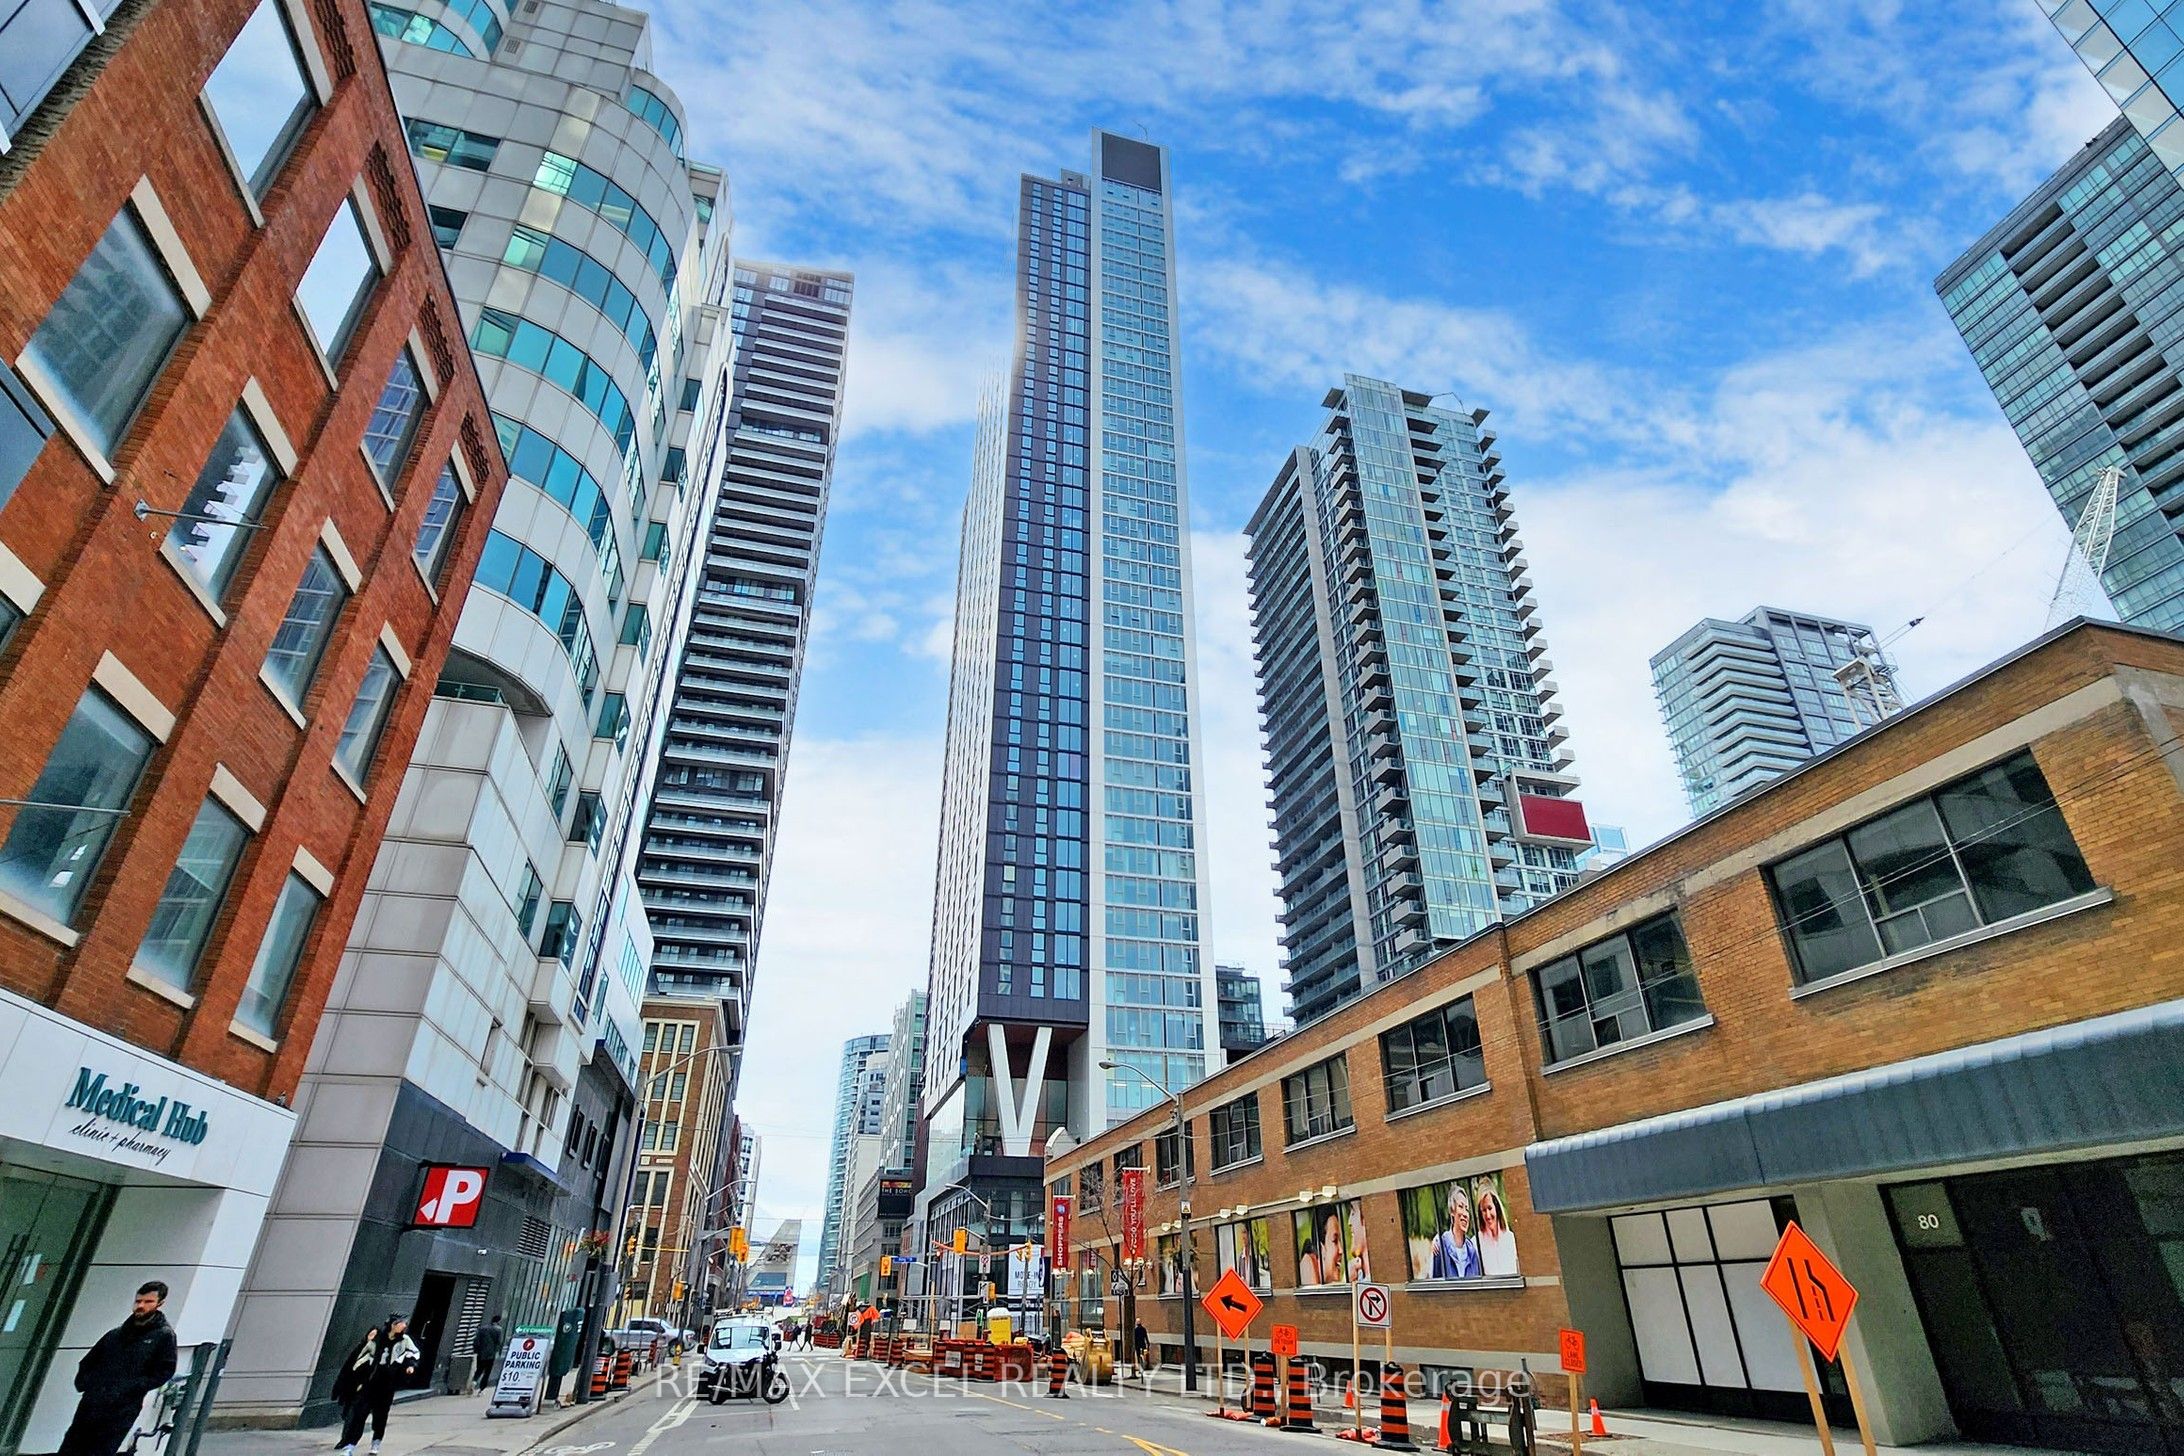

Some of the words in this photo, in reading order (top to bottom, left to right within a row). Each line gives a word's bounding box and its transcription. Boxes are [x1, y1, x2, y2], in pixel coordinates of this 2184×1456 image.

[65, 1066, 168, 1132] Medical
[161, 1100, 209, 1146] Hub
[69, 1117, 110, 1142] clinic
[112, 1131, 171, 1166] pharmacy
[434, 1169, 483, 1224] P
[1917, 1214, 1939, 1230] 80
[504, 1360, 541, 1369] PARKING
[511, 1351, 541, 1360] PUBLIC
